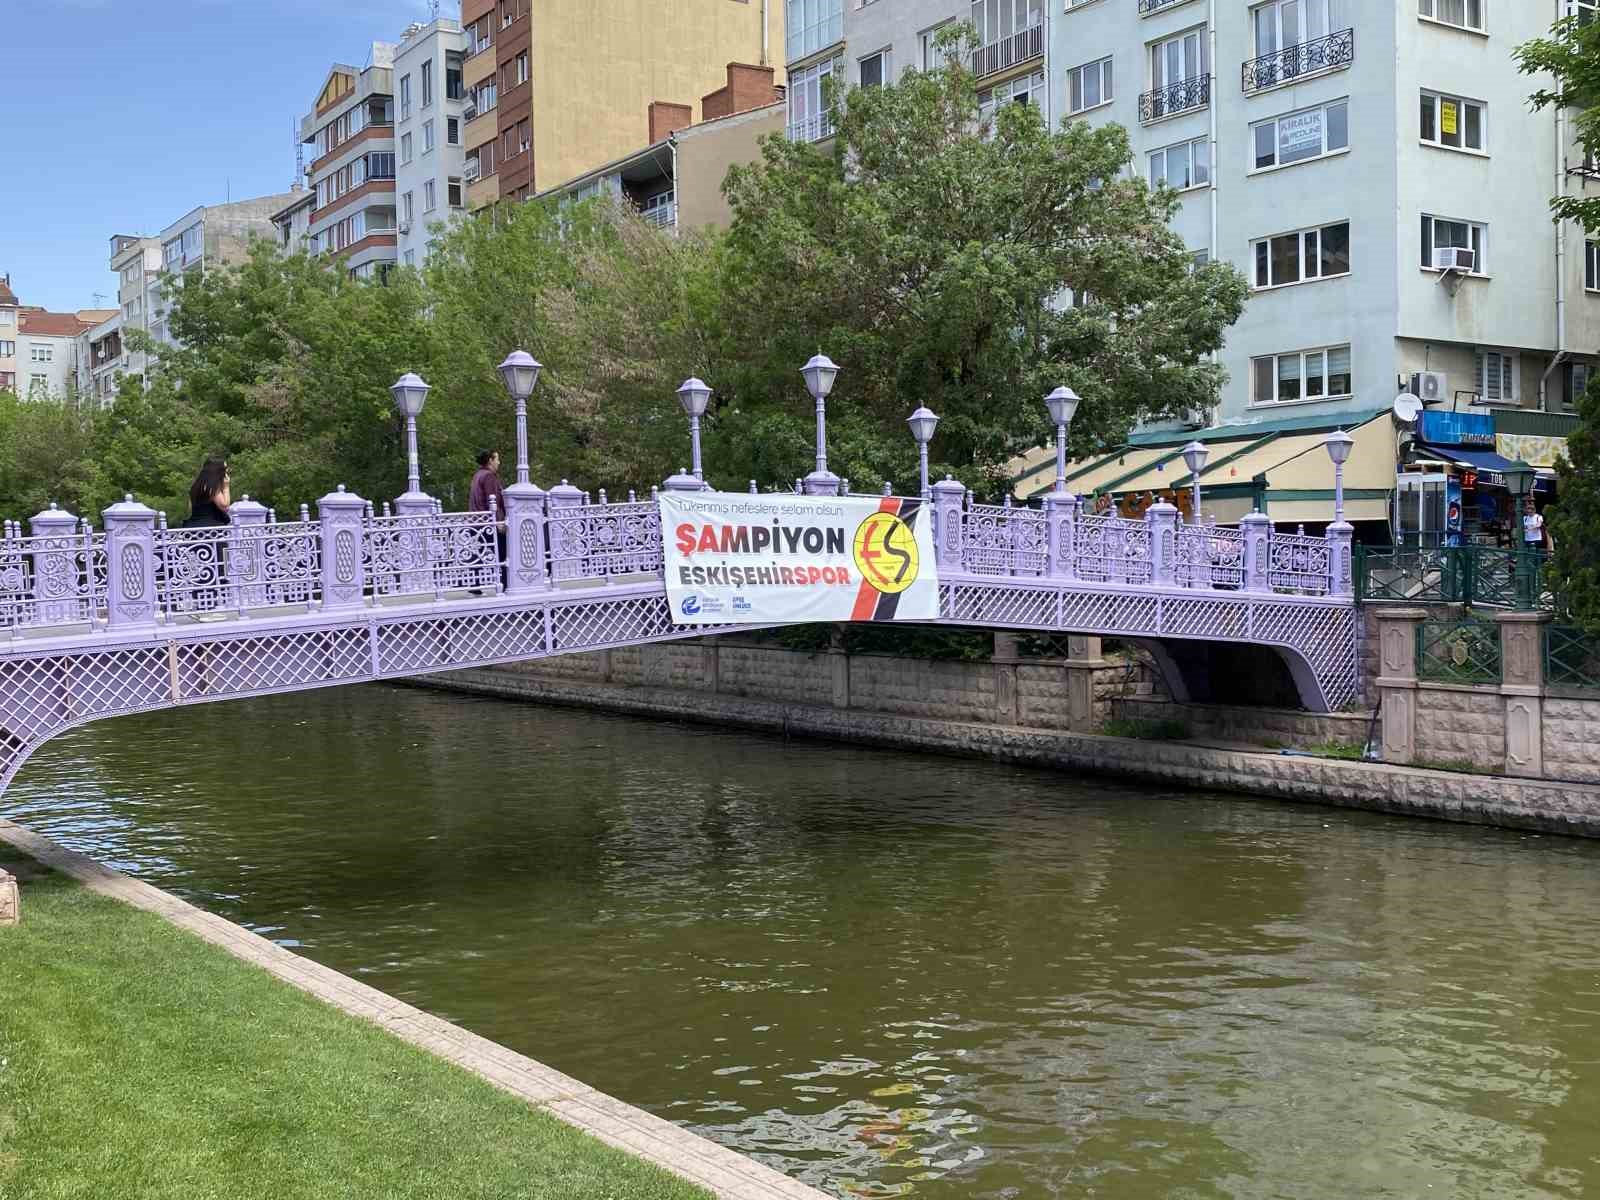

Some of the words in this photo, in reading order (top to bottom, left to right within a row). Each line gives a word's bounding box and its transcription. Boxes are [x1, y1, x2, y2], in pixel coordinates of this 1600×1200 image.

[731, 502, 778, 514] nefeslere
[781, 503, 813, 515] selam
[816, 504, 842, 516] olsun
[675, 518, 845, 557] ŞAMPİYON
[679, 561, 852, 588] ESKİŞEHİRSPOR
